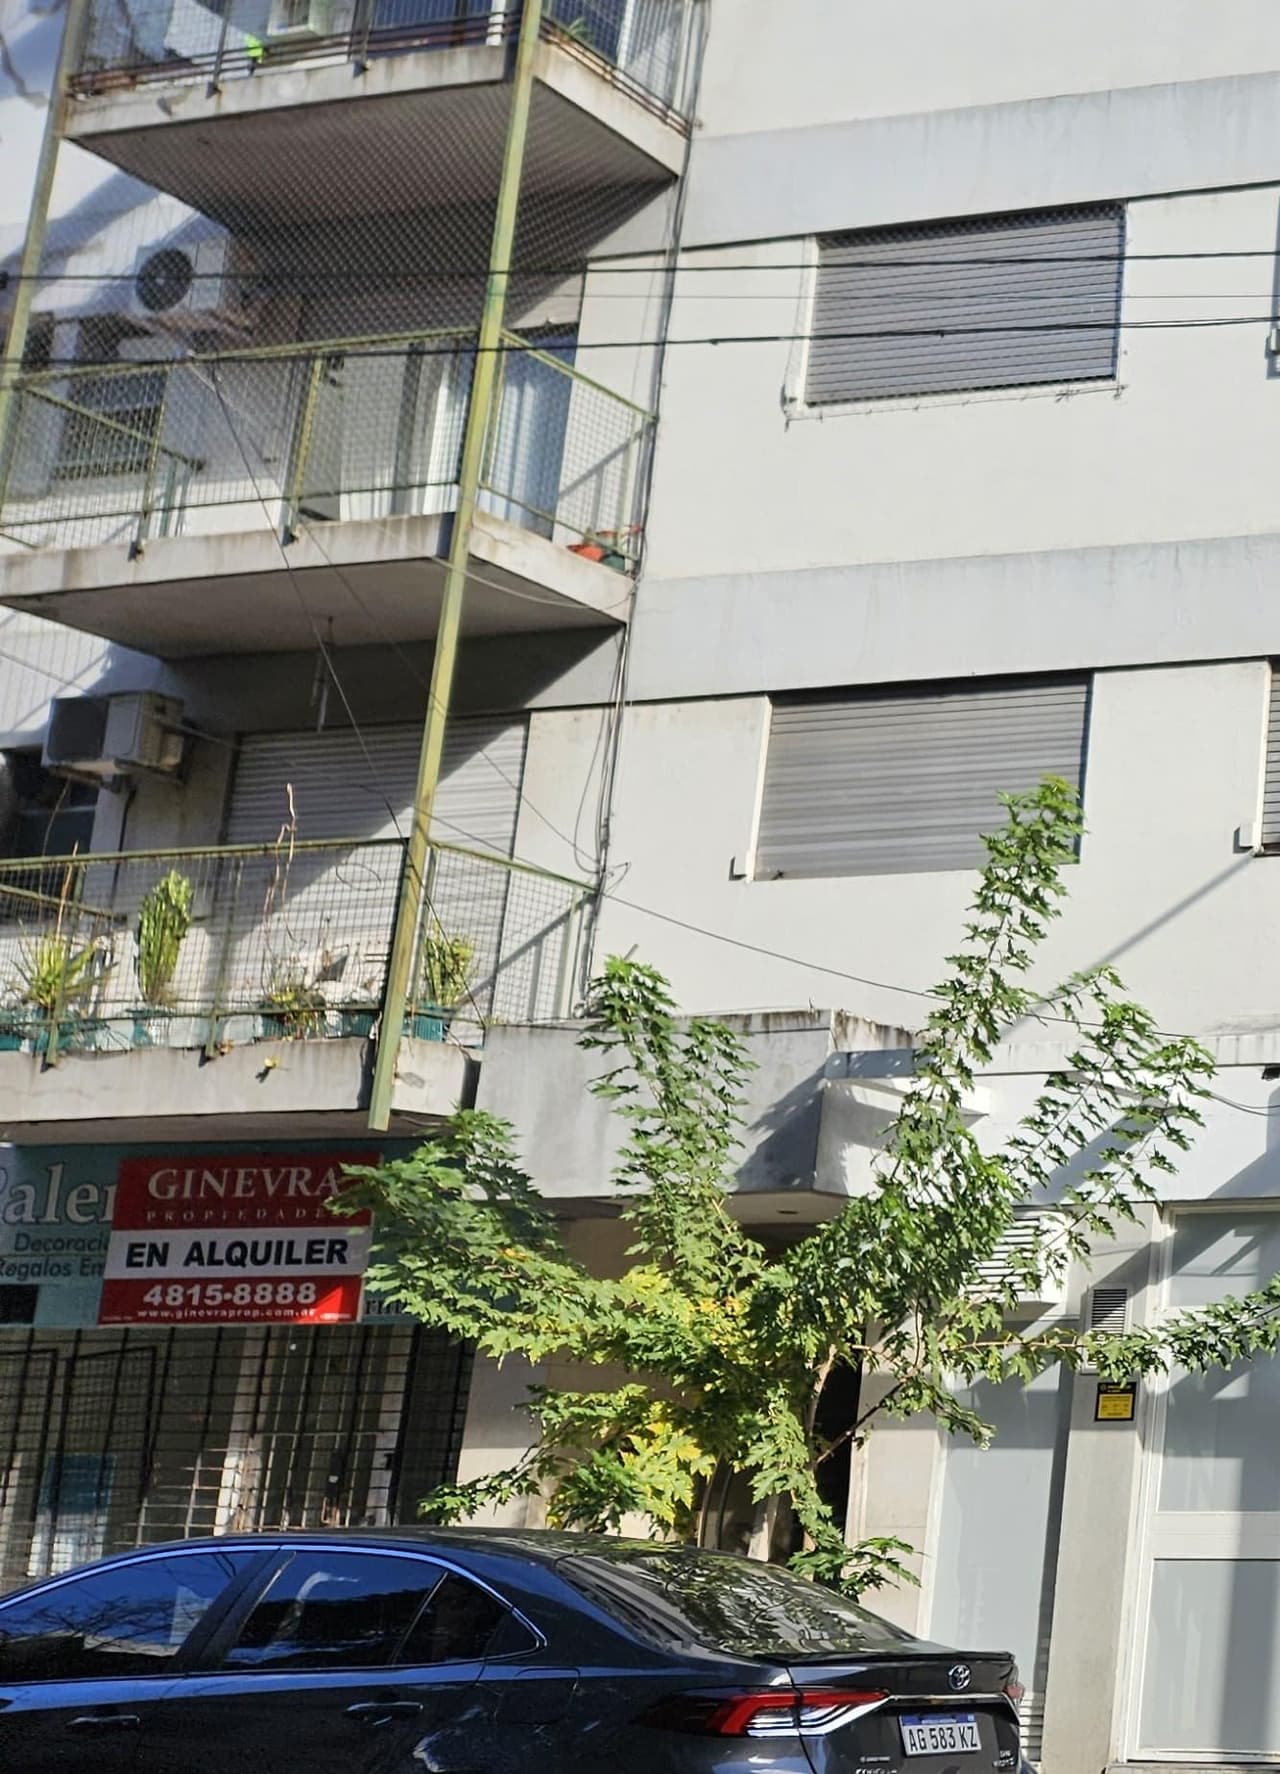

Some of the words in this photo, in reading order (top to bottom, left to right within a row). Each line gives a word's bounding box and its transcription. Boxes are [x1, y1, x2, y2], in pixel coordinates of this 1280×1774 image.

[148, 1167, 340, 1200] GINEVRA
[126, 1242, 170, 1268] EN
[183, 1239, 349, 1268] ALQUILER
[908, 1728, 927, 1751] AG
[929, 1727, 956, 1750] 583
[959, 1726, 978, 1748] KZ
